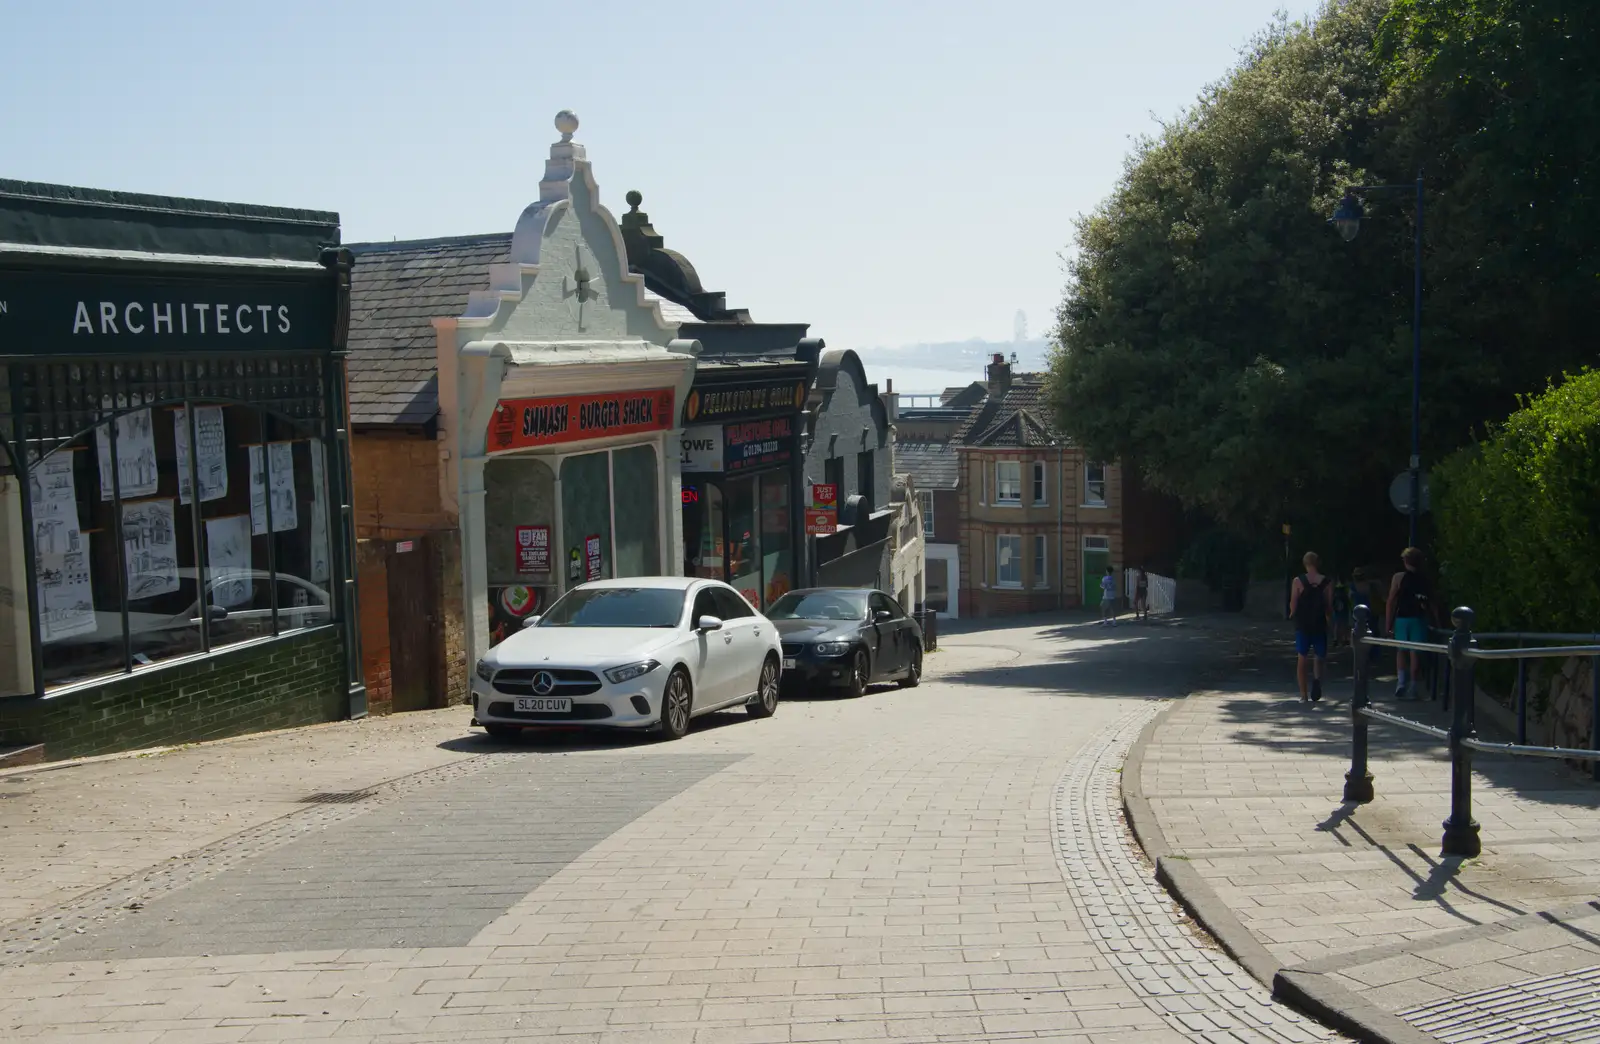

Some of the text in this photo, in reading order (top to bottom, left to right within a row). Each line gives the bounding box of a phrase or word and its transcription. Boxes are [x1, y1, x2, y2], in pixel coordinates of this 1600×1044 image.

[72, 300, 292, 334] ARCHITECTS
[580, 401, 620, 430] BURGER
[623, 398, 653, 424] SHACK
[518, 699, 567, 710] SL20 CUV
